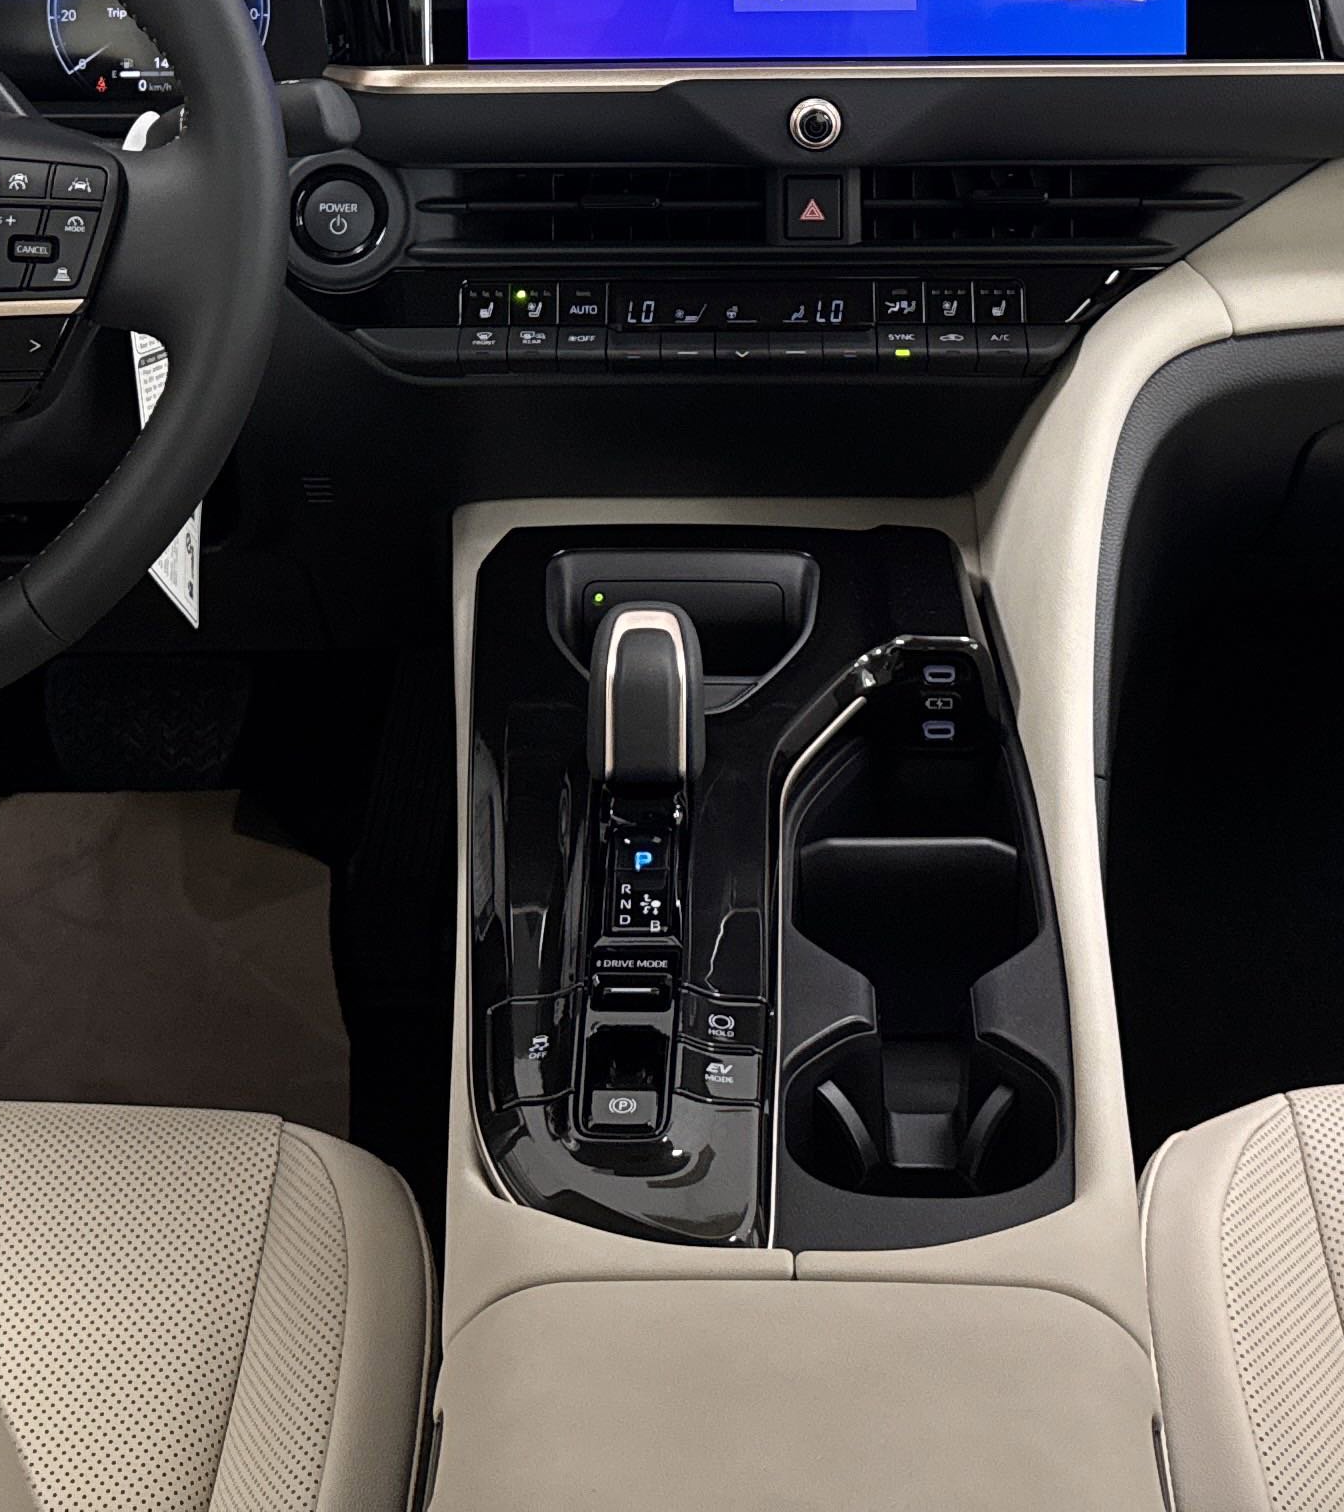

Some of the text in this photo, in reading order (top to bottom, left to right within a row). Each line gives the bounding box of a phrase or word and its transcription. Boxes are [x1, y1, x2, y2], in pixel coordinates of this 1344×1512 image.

[61, 9, 77, 22] 20
[107, 7, 128, 20] Trip
[138, 79, 173, 93] 0 km/h
[318, 203, 358, 213] POWER
[64, 225, 86, 233] MODE
[16, 245, 49, 255] CANCEL
[569, 304, 598, 315] AUTO
[990, 334, 1009, 342] A/C
[635, 851, 652, 871] P
[621, 884, 631, 895] R
[620, 899, 631, 910] N
[619, 915, 631, 925] D
[650, 921, 661, 932] B
[603, 959, 668, 968] DRIVE MODE
[708, 1029, 735, 1037] HOLD
[529, 1050, 547, 1060] OFF
[706, 1063, 732, 1075] EV
[705, 1073, 734, 1084] MODE
